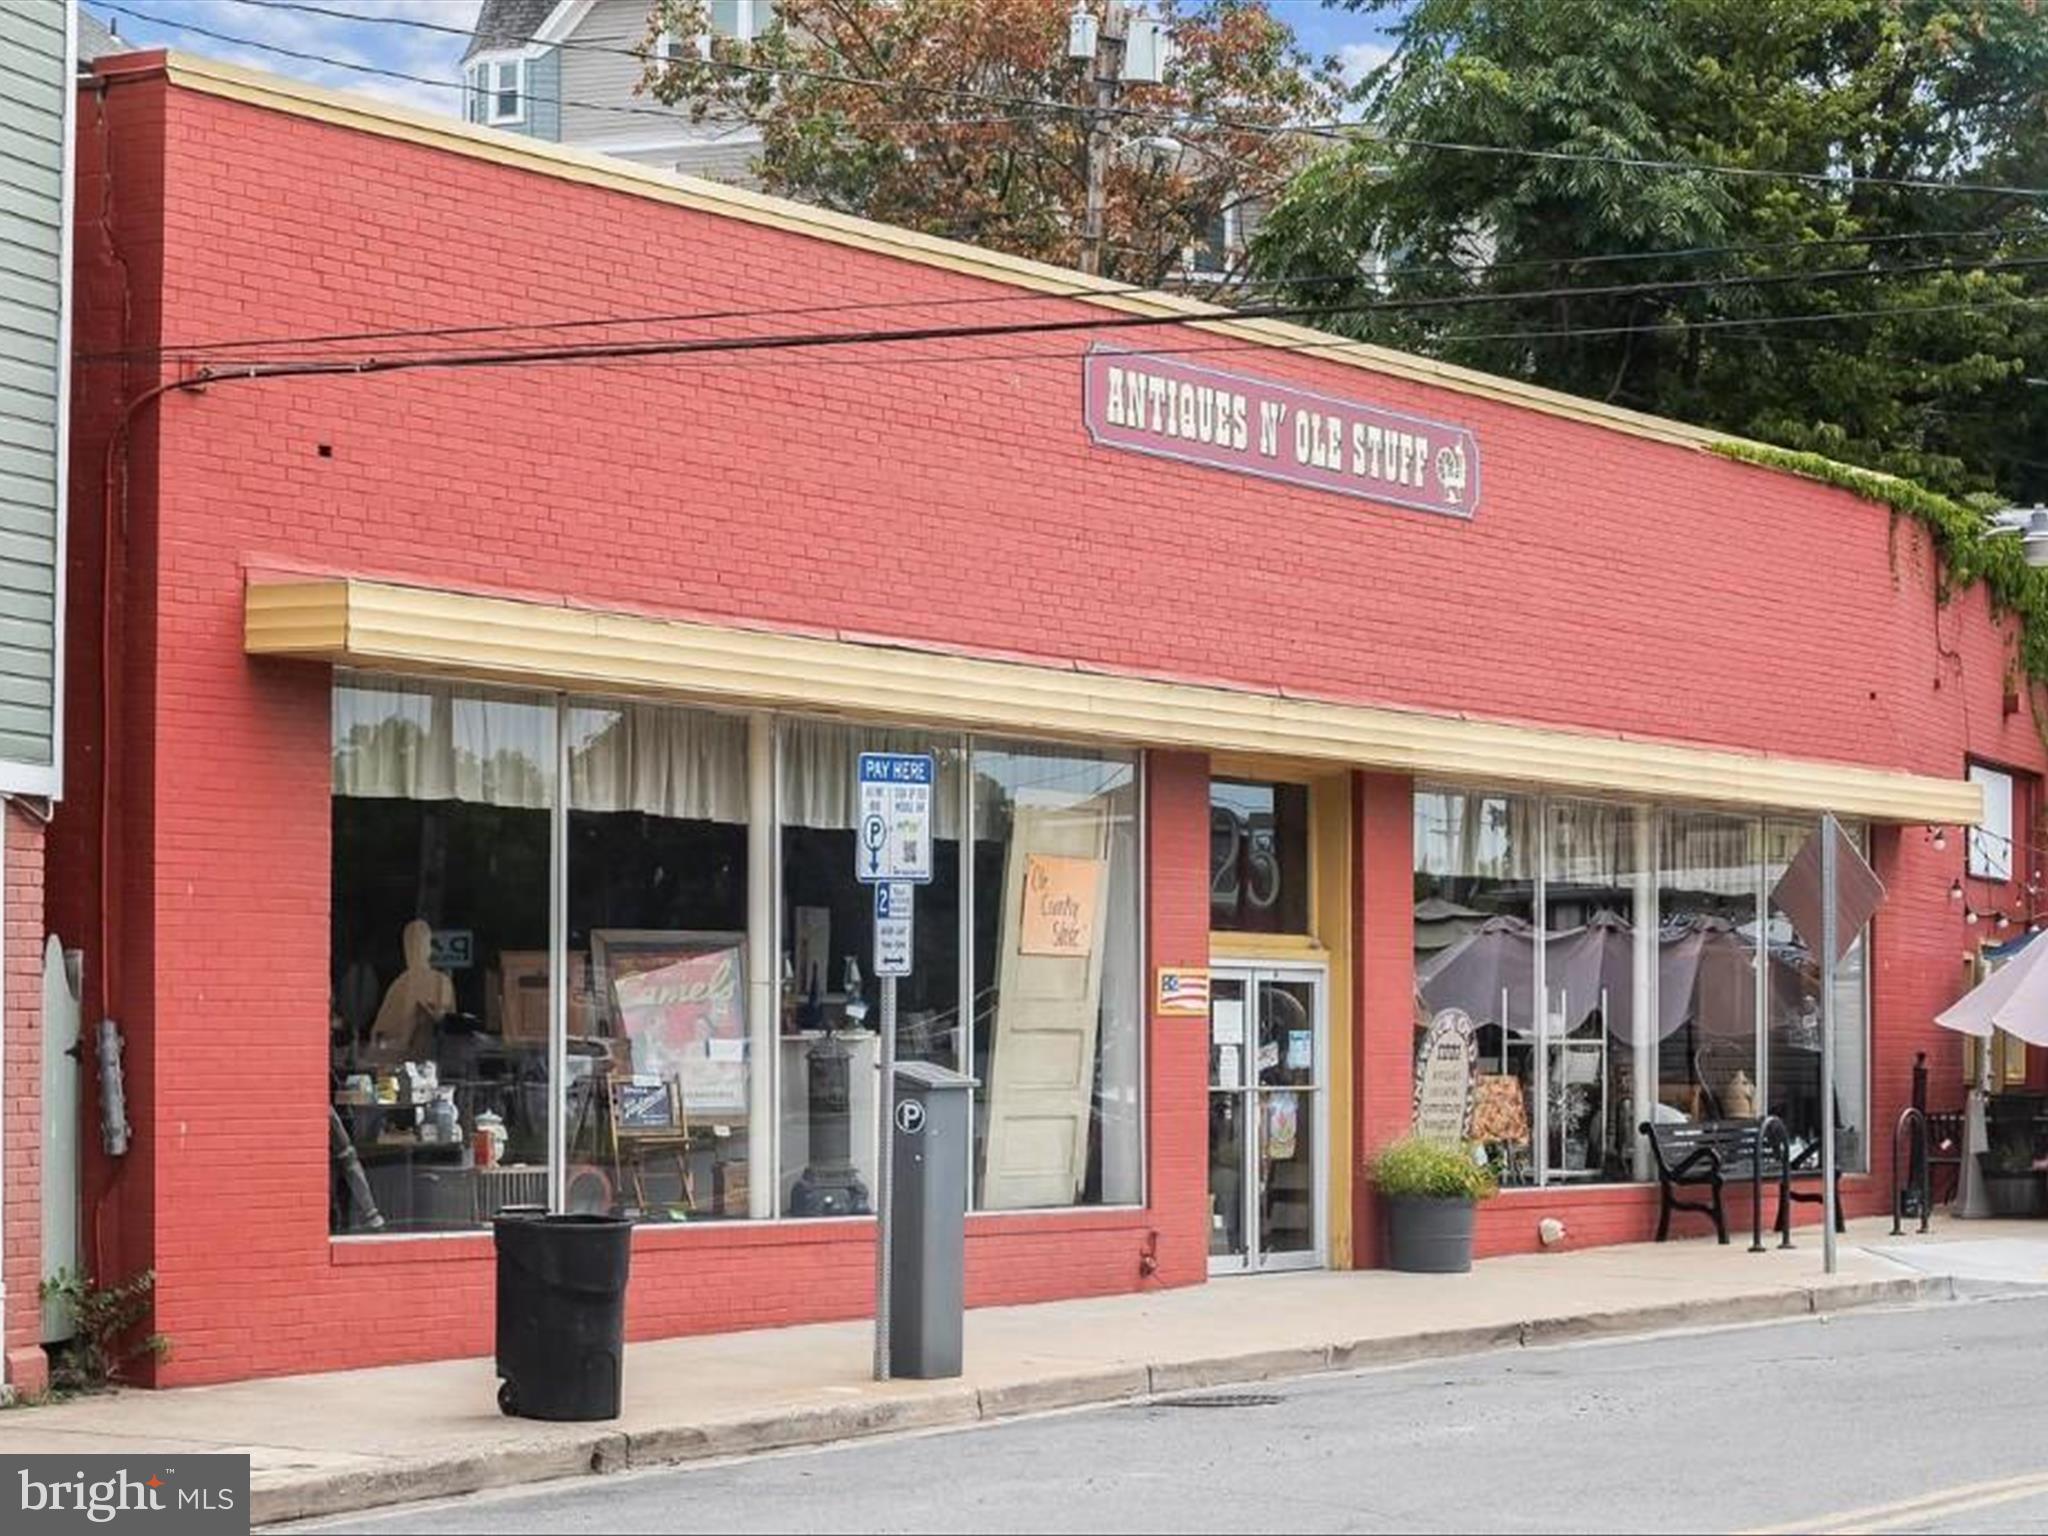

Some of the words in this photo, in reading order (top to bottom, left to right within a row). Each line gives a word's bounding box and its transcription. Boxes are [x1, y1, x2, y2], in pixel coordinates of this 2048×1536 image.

[1107, 367, 1249, 451] ANTIQUES
[1295, 409, 1342, 472] OLE
[1352, 414, 1429, 487] STUFF
[865, 760, 890, 780] PAY
[893, 761, 926, 781] HERE
[879, 890, 888, 913] 2
[903, 1103, 920, 1130] P
